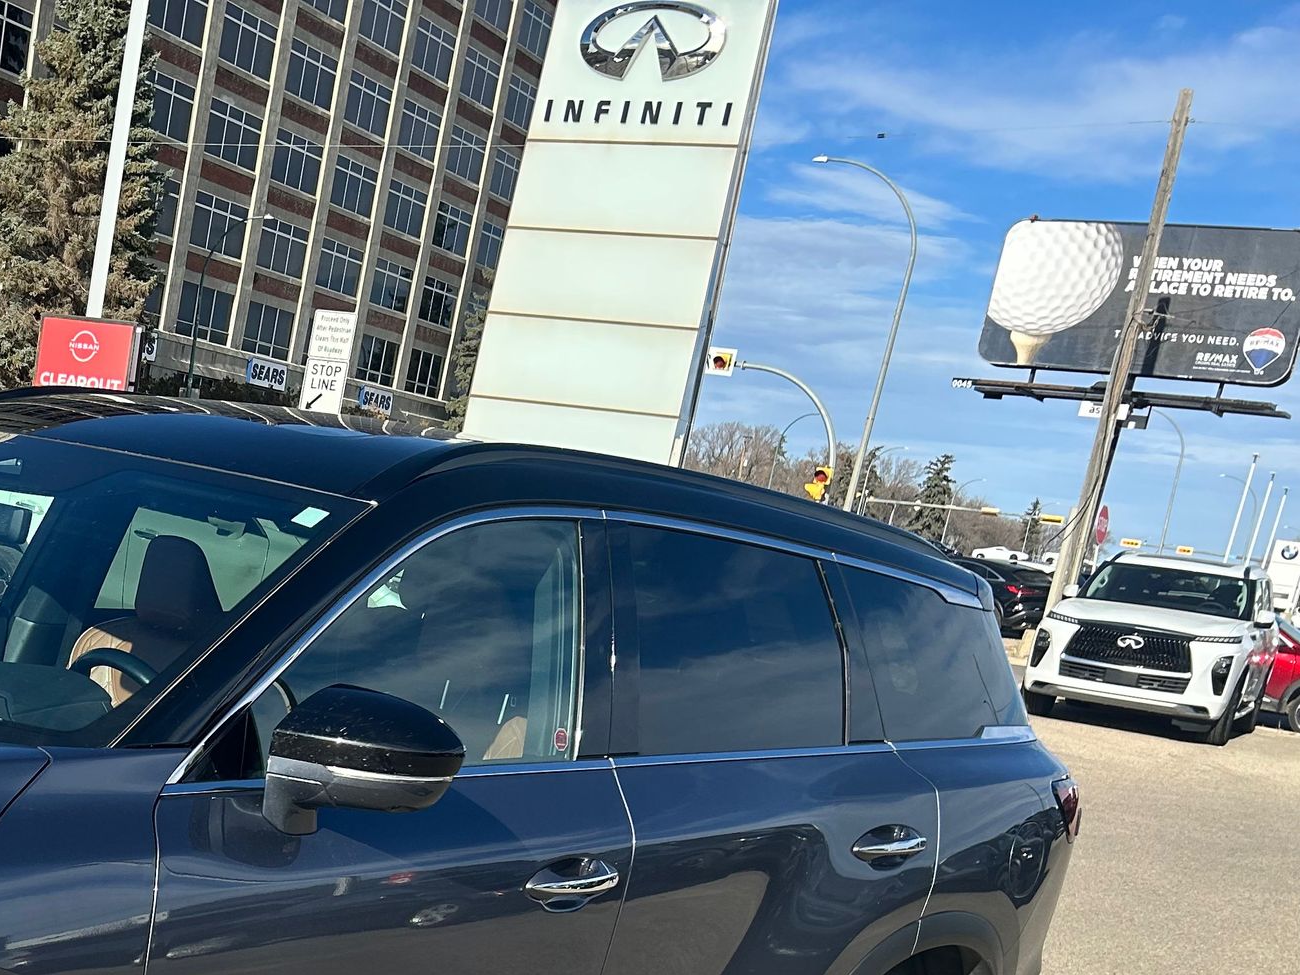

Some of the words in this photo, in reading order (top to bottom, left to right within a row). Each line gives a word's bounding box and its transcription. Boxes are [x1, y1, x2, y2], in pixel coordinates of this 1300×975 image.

[543, 99, 733, 126] INFINITI
[1182, 257, 1224, 272] YOUR
[1128, 268, 1225, 285] RTIREMENT
[1225, 273, 1278, 287] NEEDS
[1148, 283, 1188, 295] LACE
[1191, 284, 1211, 297] TO
[1213, 285, 1269, 299] RETIRE
[1272, 288, 1297, 302] TO.
[68, 341, 100, 352] NISSAN
[1181, 333, 1205, 344] YOU
[1207, 335, 1240, 346] NEED.
[1195, 352, 1239, 364] RE/MAX
[251, 363, 286, 386] SEARS
[311, 363, 342, 378] STOP
[310, 378, 337, 391] LINE
[951, 379, 973, 389] 0045
[362, 390, 393, 411] SEARS
